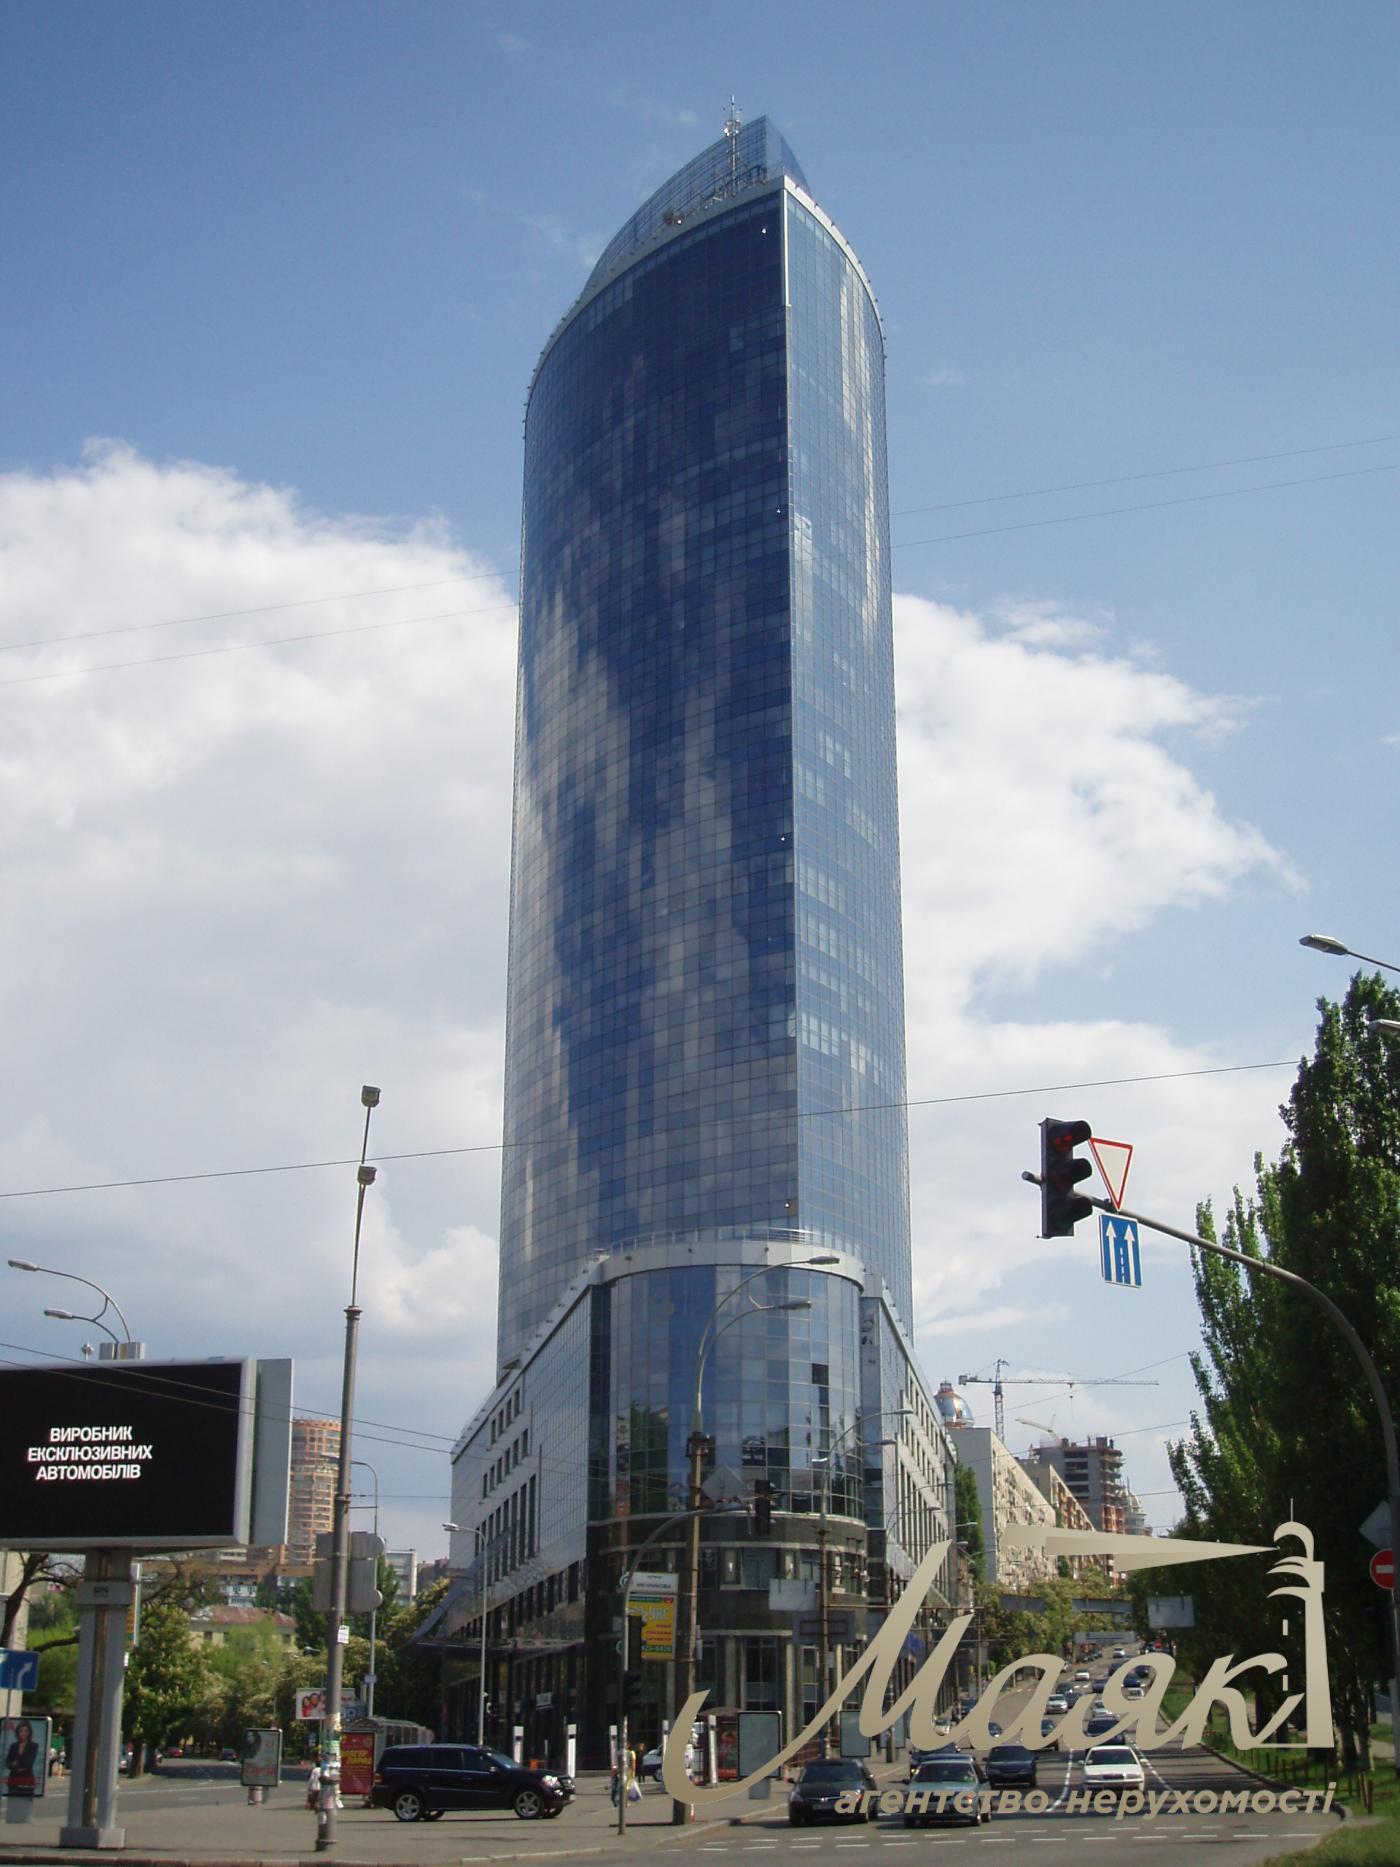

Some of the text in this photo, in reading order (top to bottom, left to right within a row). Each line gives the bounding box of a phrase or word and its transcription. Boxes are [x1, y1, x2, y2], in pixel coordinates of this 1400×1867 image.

[50, 1426, 132, 1442] ВИРОБНИК
[28, 1445, 152, 1461] ЕКСКЛЮЗИВНИХ
[36, 1464, 141, 1480] АВТОМОБІЛІВ
